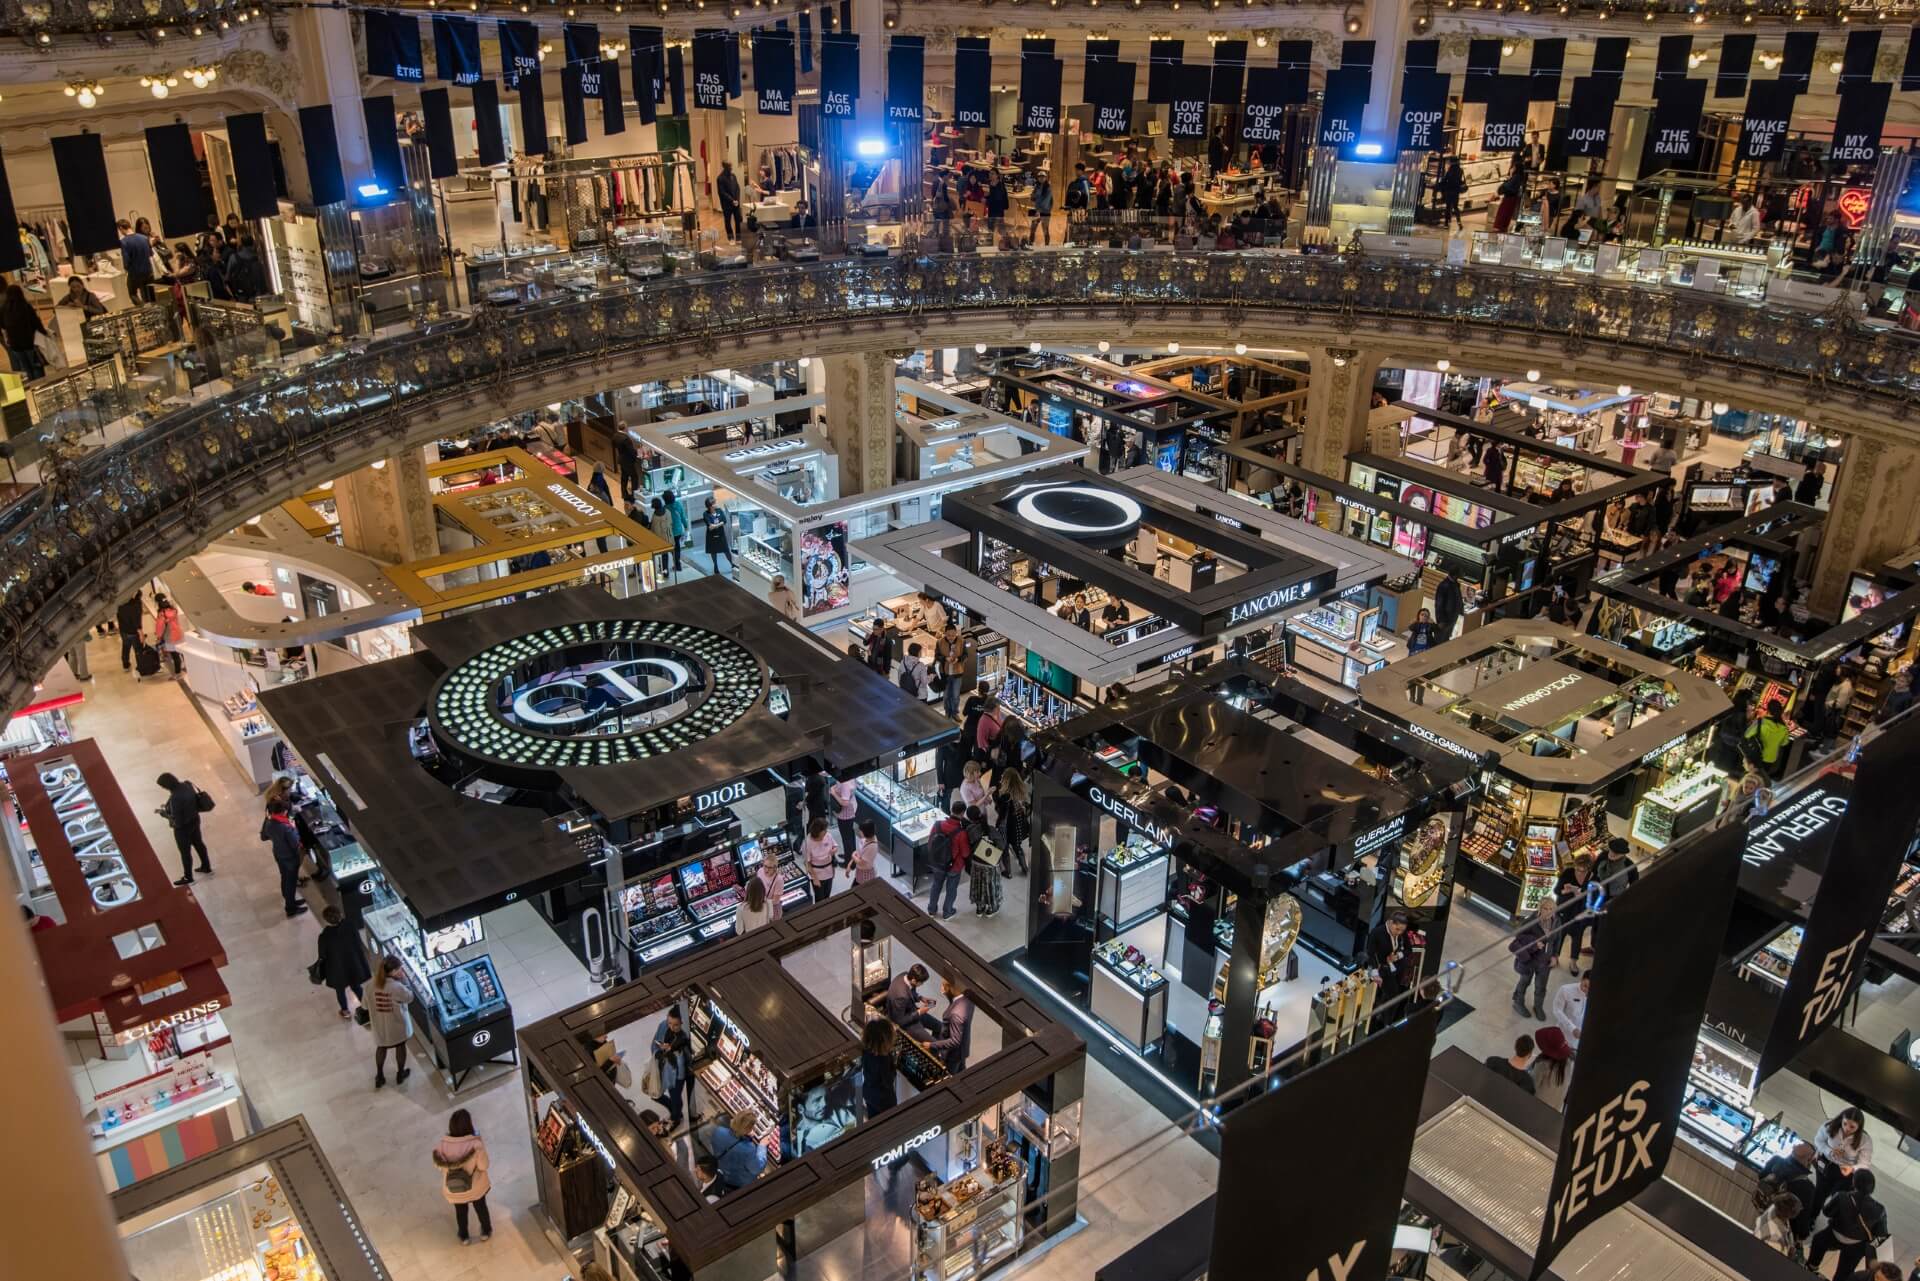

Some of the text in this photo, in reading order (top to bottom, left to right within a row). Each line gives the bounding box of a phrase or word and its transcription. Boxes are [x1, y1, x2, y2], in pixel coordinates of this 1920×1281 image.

[514, 56, 536, 68] SUR
[396, 63, 422, 79] ÊTRE
[582, 73, 600, 84] ANT
[700, 73, 720, 85] PAS
[581, 84, 599, 94] OU
[696, 83, 724, 96] TROP
[766, 89, 783, 100] MA
[699, 94, 723, 106] VITE
[828, 91, 849, 104] ÂGE
[760, 99, 790, 112] DAME
[824, 103, 851, 116] D'OR
[1031, 106, 1053, 117] SEE
[1174, 101, 1205, 113] LOVE
[1247, 104, 1282, 117] COUP
[890, 107, 920, 118] FATAL
[959, 110, 986, 123] IDOL
[1101, 107, 1125, 119] BUY
[1176, 112, 1200, 124] FOR
[1405, 111, 1442, 124] COUP
[1027, 116, 1055, 129] NOW
[1098, 118, 1126, 131] NOW
[1172, 123, 1203, 135] SALE
[1254, 116, 1271, 129] DE
[1331, 119, 1350, 131] FIL
[1413, 123, 1431, 135] DE
[1745, 119, 1787, 133] WAKE
[1243, 128, 1281, 141] CŒUR
[1485, 123, 1525, 136] CŒUR
[1568, 128, 1606, 142] JOUR
[1661, 129, 1690, 142] THE
[1323, 130, 1355, 143] NOIR
[1411, 134, 1430, 147] FIL
[1486, 135, 1520, 147] NOIR
[1751, 132, 1773, 145] ME
[1844, 134, 1868, 147] MY
[1580, 141, 1590, 153] J
[1655, 141, 1691, 154] RAIN
[1749, 144, 1771, 157] UP
[1833, 147, 1874, 160] HERO
[1335, 495, 1376, 515] shu uemura
[584, 556, 635, 576] L'OCCITANE
[1230, 584, 1299, 624] LANCÔME
[1162, 645, 1194, 663] LANCÔME
[696, 782, 749, 812] DIOR
[1089, 787, 1173, 848] GUERLAIN
[40, 763, 138, 908] CLARINS
[1355, 815, 1405, 848] GUERLAIN
[1742, 796, 1848, 868] GUERLAIN
[1813, 929, 1866, 994] ET
[1799, 970, 1853, 1041] TOI
[124, 999, 221, 1041] CLARINS
[709, 999, 750, 1048] TOM FORD
[1704, 1013, 1746, 1043] LAIN
[1572, 1080, 1651, 1171] TES
[871, 1125, 942, 1170] TOM FORD
[1552, 1121, 1661, 1243] YEUX
